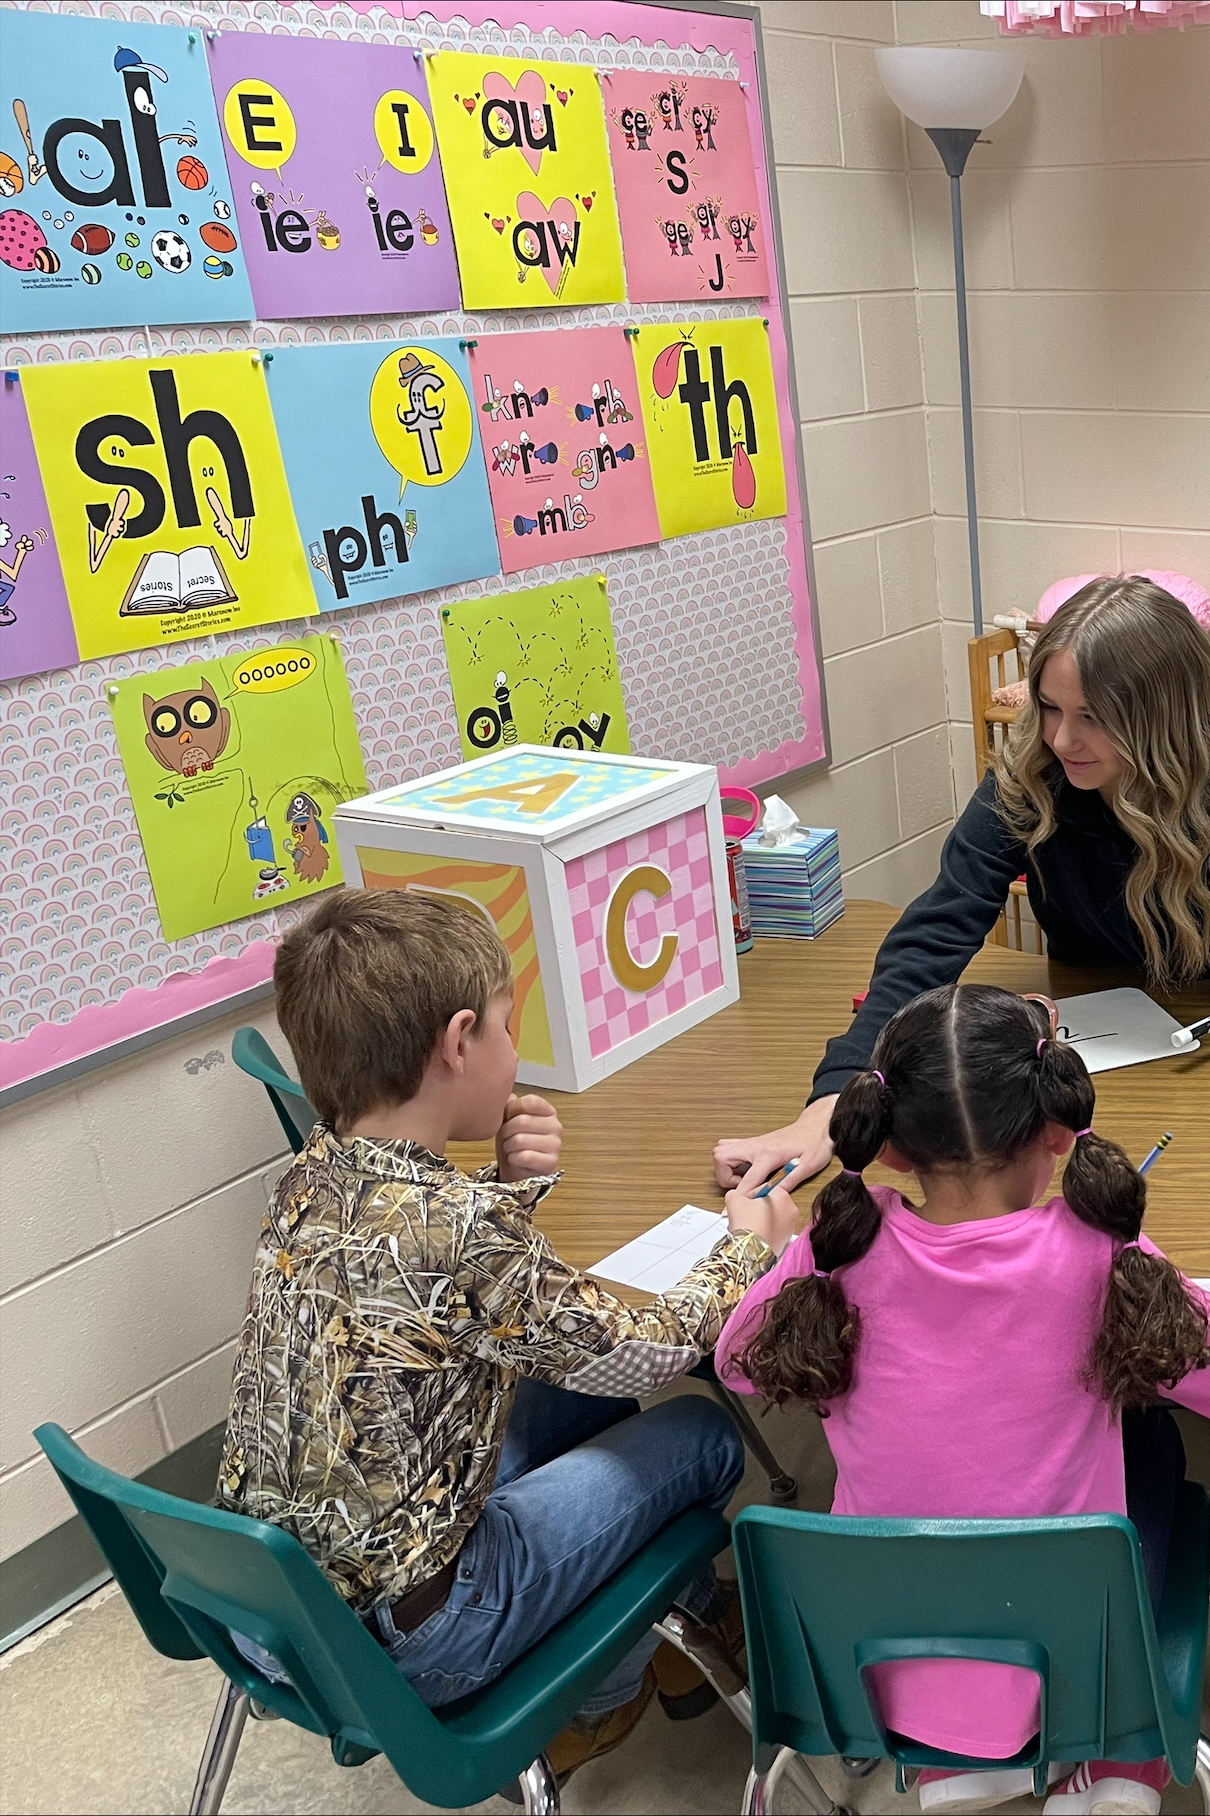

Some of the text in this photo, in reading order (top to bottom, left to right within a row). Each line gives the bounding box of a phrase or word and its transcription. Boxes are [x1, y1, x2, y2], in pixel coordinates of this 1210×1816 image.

[43, 71, 173, 208] al
[238, 94, 283, 152] E
[391, 102, 417, 157] I
[482, 98, 558, 152] au
[621, 109, 648, 133] ce
[692, 108, 713, 135] cy
[255, 193, 313, 254] ie
[366, 196, 415, 251] ie
[512, 219, 581, 269] aw
[665, 222, 689, 244] ge
[729, 216, 752, 240] gy
[708, 253, 725, 292] J
[483, 373, 535, 422] kn
[593, 379, 629, 428] rh
[678, 345, 758, 463] th
[75, 369, 256, 539] sh
[492, 441, 536, 478] wr
[576, 443, 619, 491] gn
[537, 494, 590, 536] mb
[322, 494, 409, 600] ph
[140, 575, 216, 594] Secret Stories
[160, 616, 186, 627] Copyright
[466, 686, 515, 750] oi
[432, 773, 585, 815] A
[606, 862, 680, 994] C
